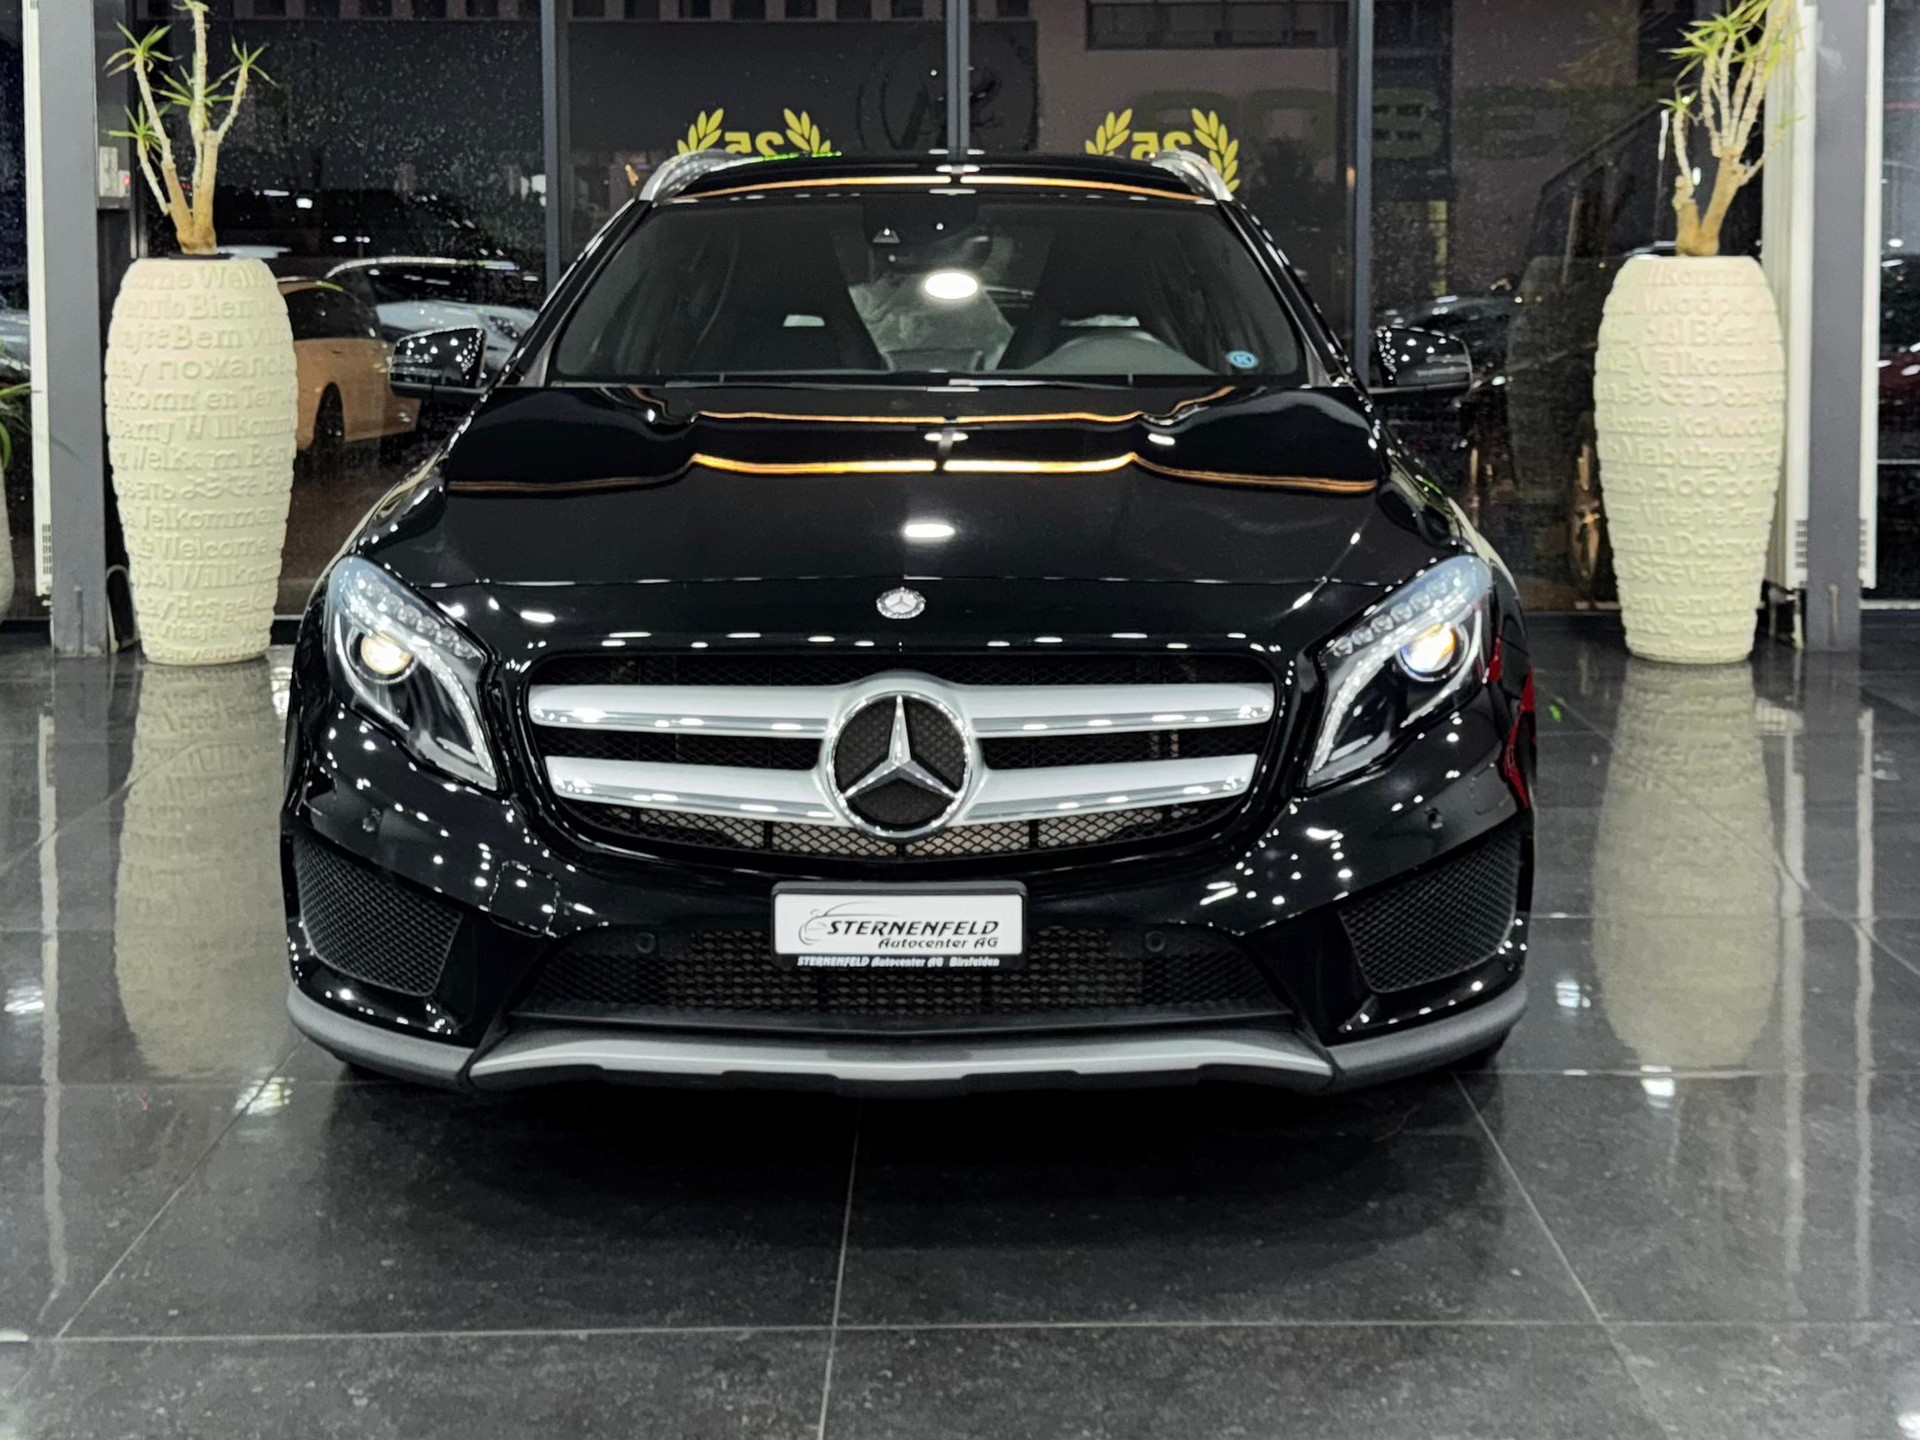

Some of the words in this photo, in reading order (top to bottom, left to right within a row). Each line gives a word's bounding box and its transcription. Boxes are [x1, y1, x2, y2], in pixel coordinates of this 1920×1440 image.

[827, 920, 999, 937] STERNENFELD
[879, 937, 968, 949] Autocenter
[974, 937, 999, 948] AG
[797, 957, 870, 967] STERNENFELD
[871, 957, 926, 967] Autocenter
